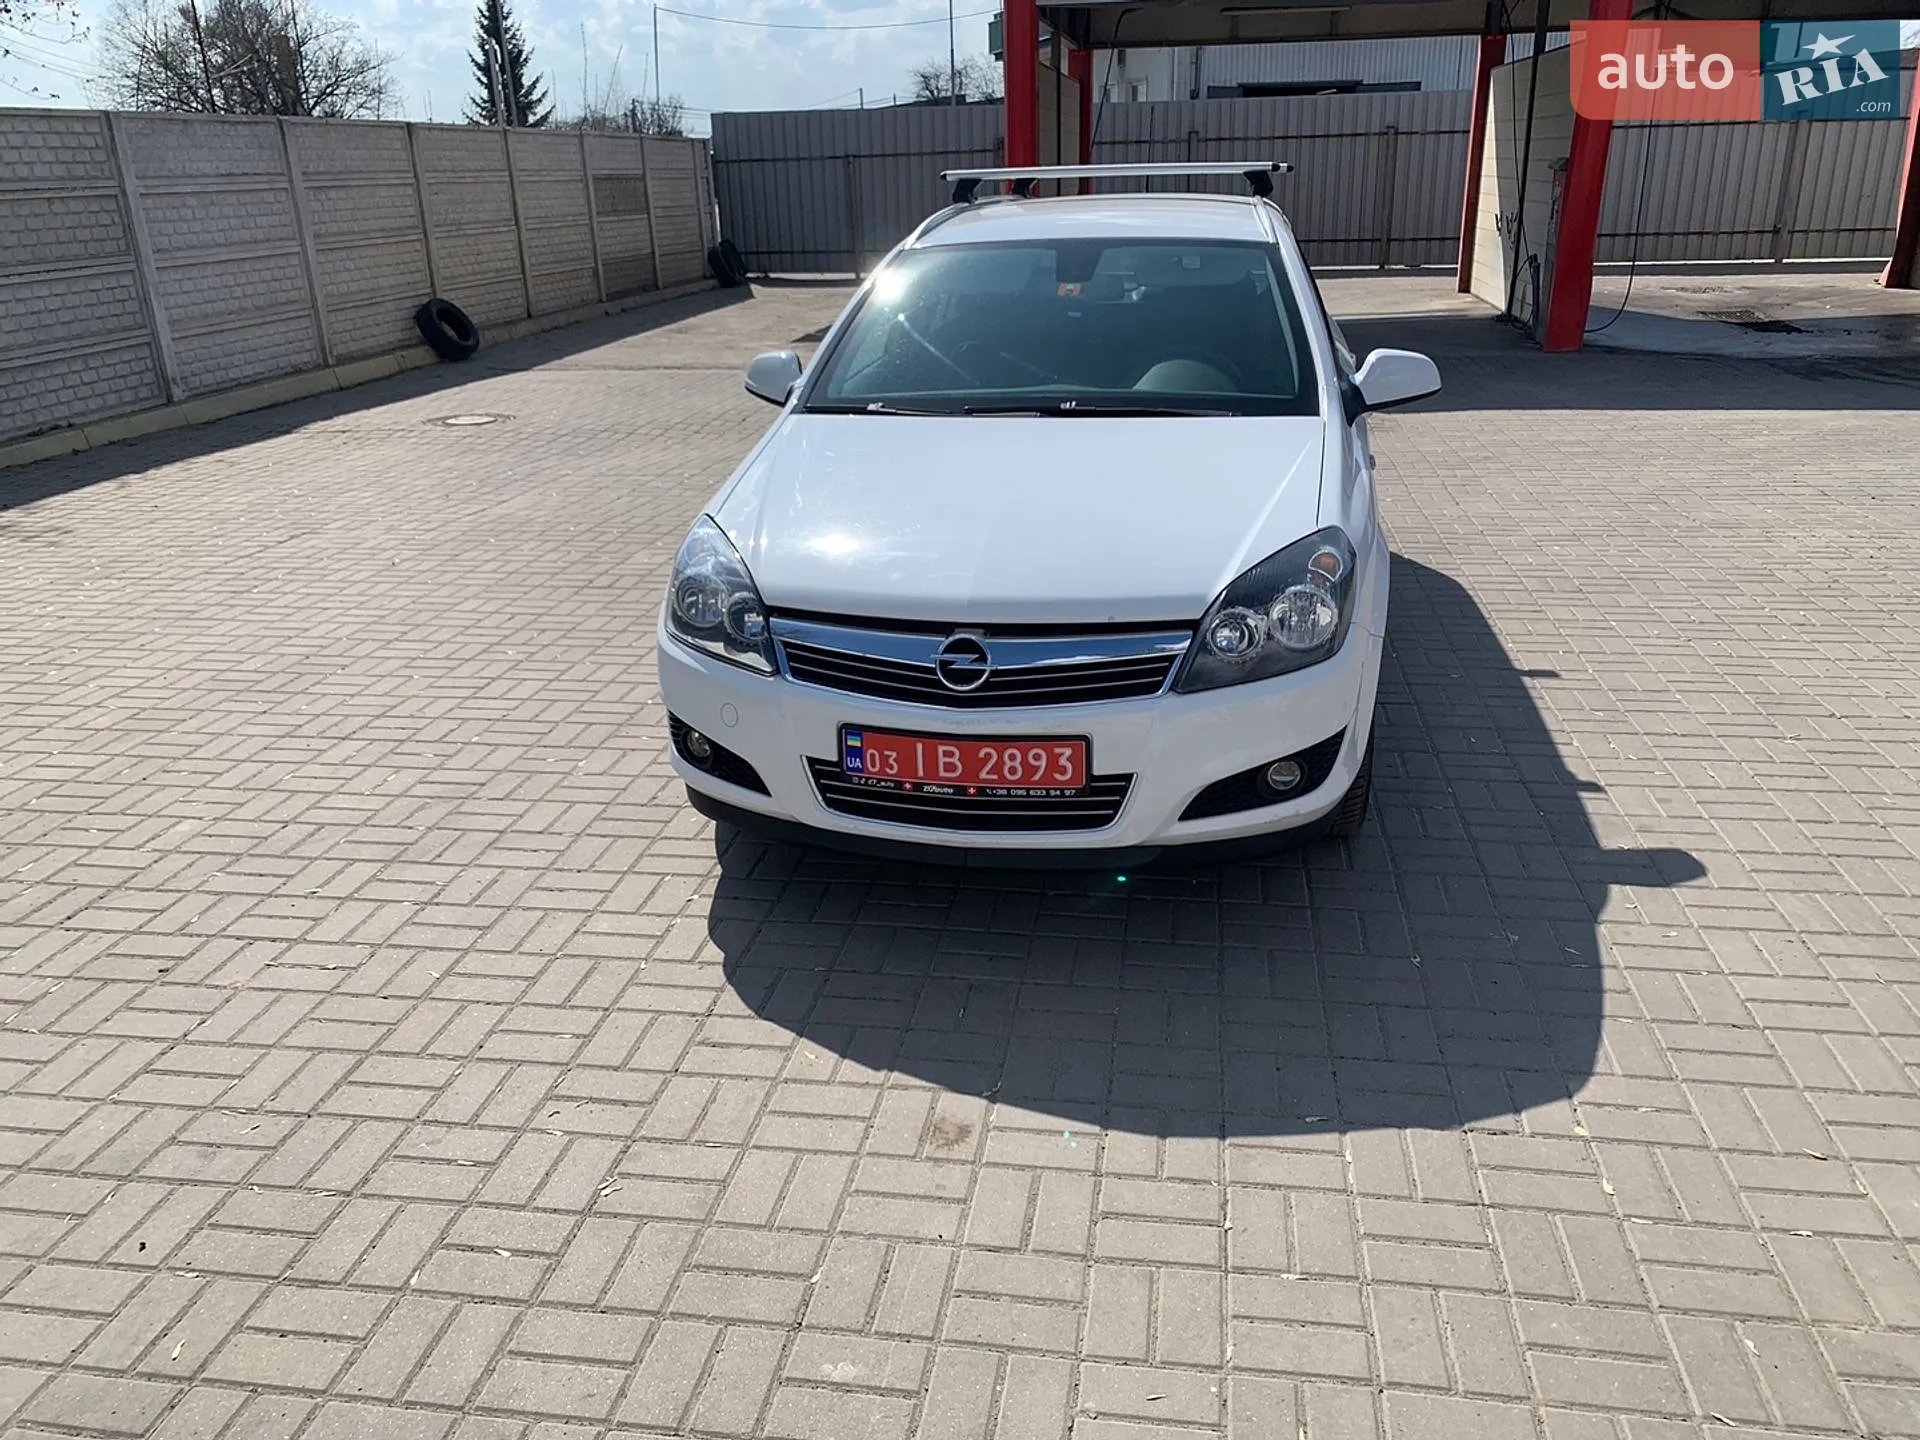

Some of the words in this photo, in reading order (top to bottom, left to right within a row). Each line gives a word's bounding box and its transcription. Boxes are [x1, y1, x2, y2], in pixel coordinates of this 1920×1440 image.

[847, 757, 862, 768] UA
[866, 748, 898, 775] 03
[916, 742, 963, 777] IB
[978, 746, 1073, 781] 2893
